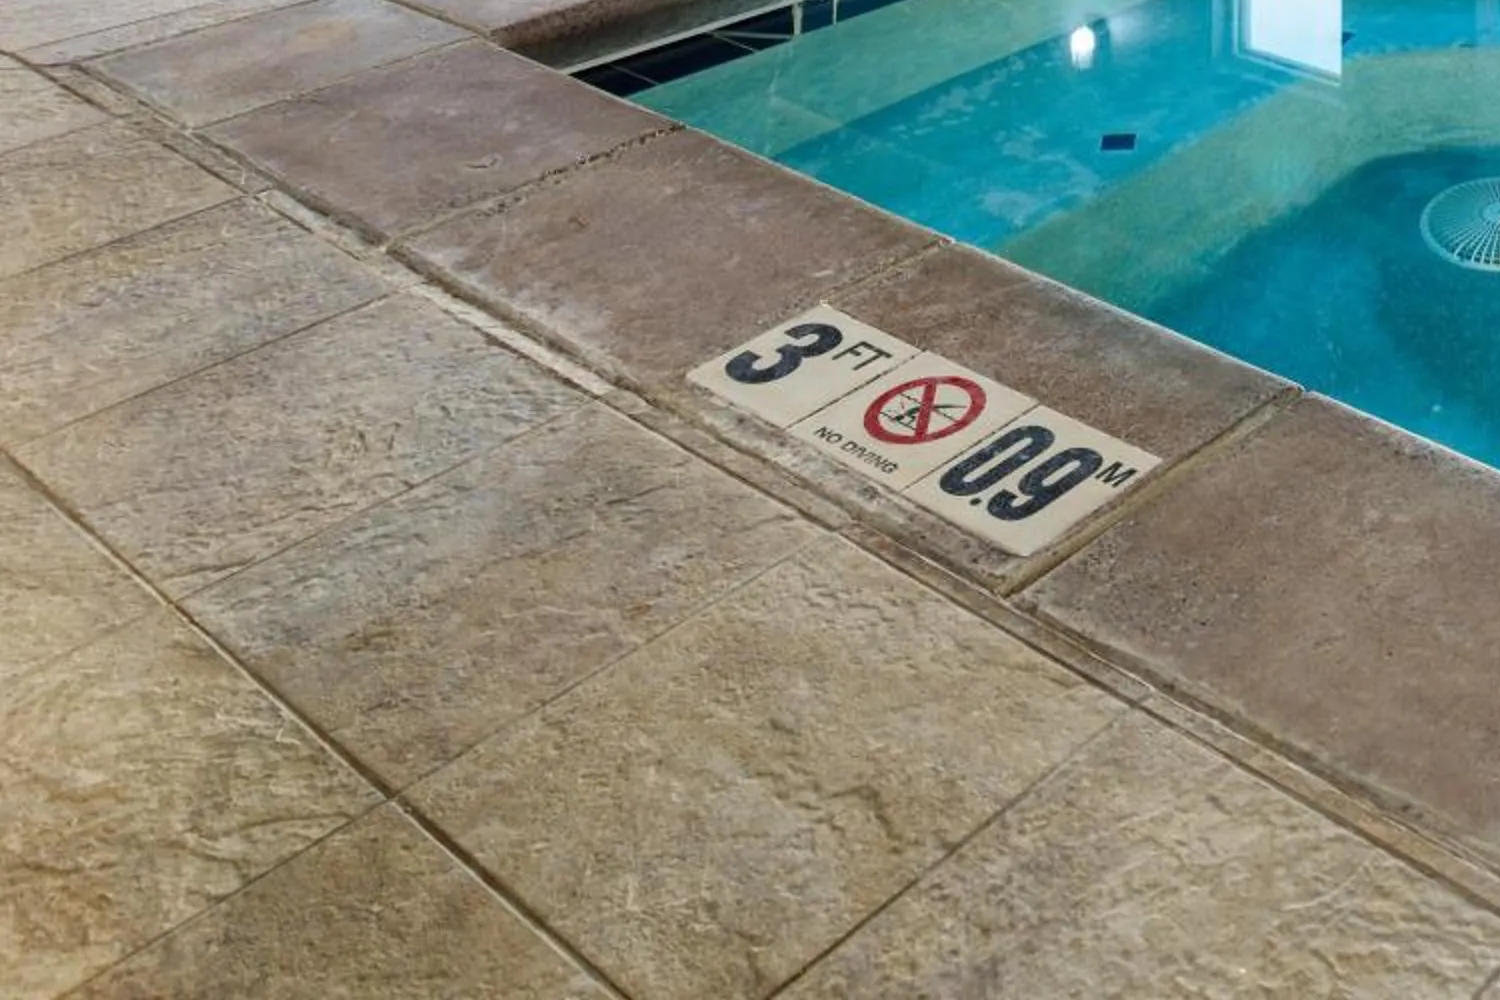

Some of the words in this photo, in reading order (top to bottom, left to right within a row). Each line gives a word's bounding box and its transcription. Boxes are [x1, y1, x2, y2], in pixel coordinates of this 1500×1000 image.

[725, 322, 843, 384] 3
[831, 340, 892, 371] FT
[813, 426, 843, 444] NO
[841, 440, 899, 473] DIVING
[938, 424, 1104, 522] 0.9
[1096, 460, 1139, 489] M
